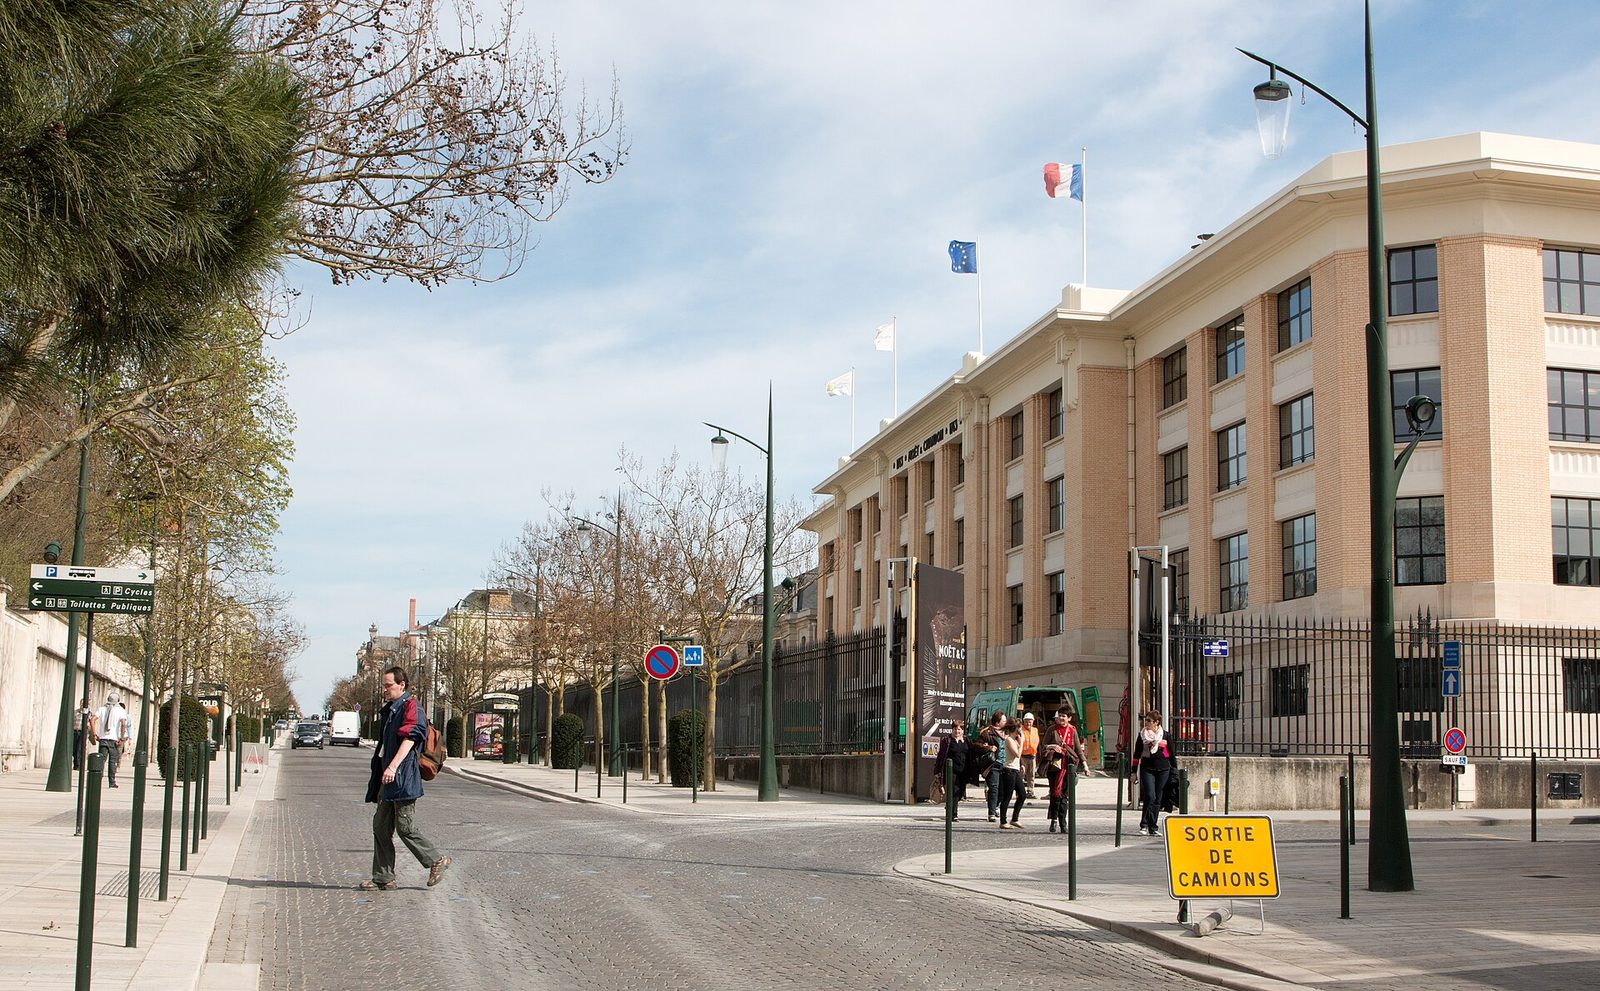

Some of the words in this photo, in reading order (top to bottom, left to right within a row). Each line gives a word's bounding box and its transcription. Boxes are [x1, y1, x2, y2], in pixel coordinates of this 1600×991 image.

[124, 587, 153, 596] Cycles
[70, 600, 106, 609] Toilettes
[111, 602, 152, 612] Publiques
[939, 644, 956, 658] MOËT
[1184, 826, 1255, 842] SORTIE
[1209, 849, 1234, 864] DE
[1178, 871, 1270, 887] CAMIONS
